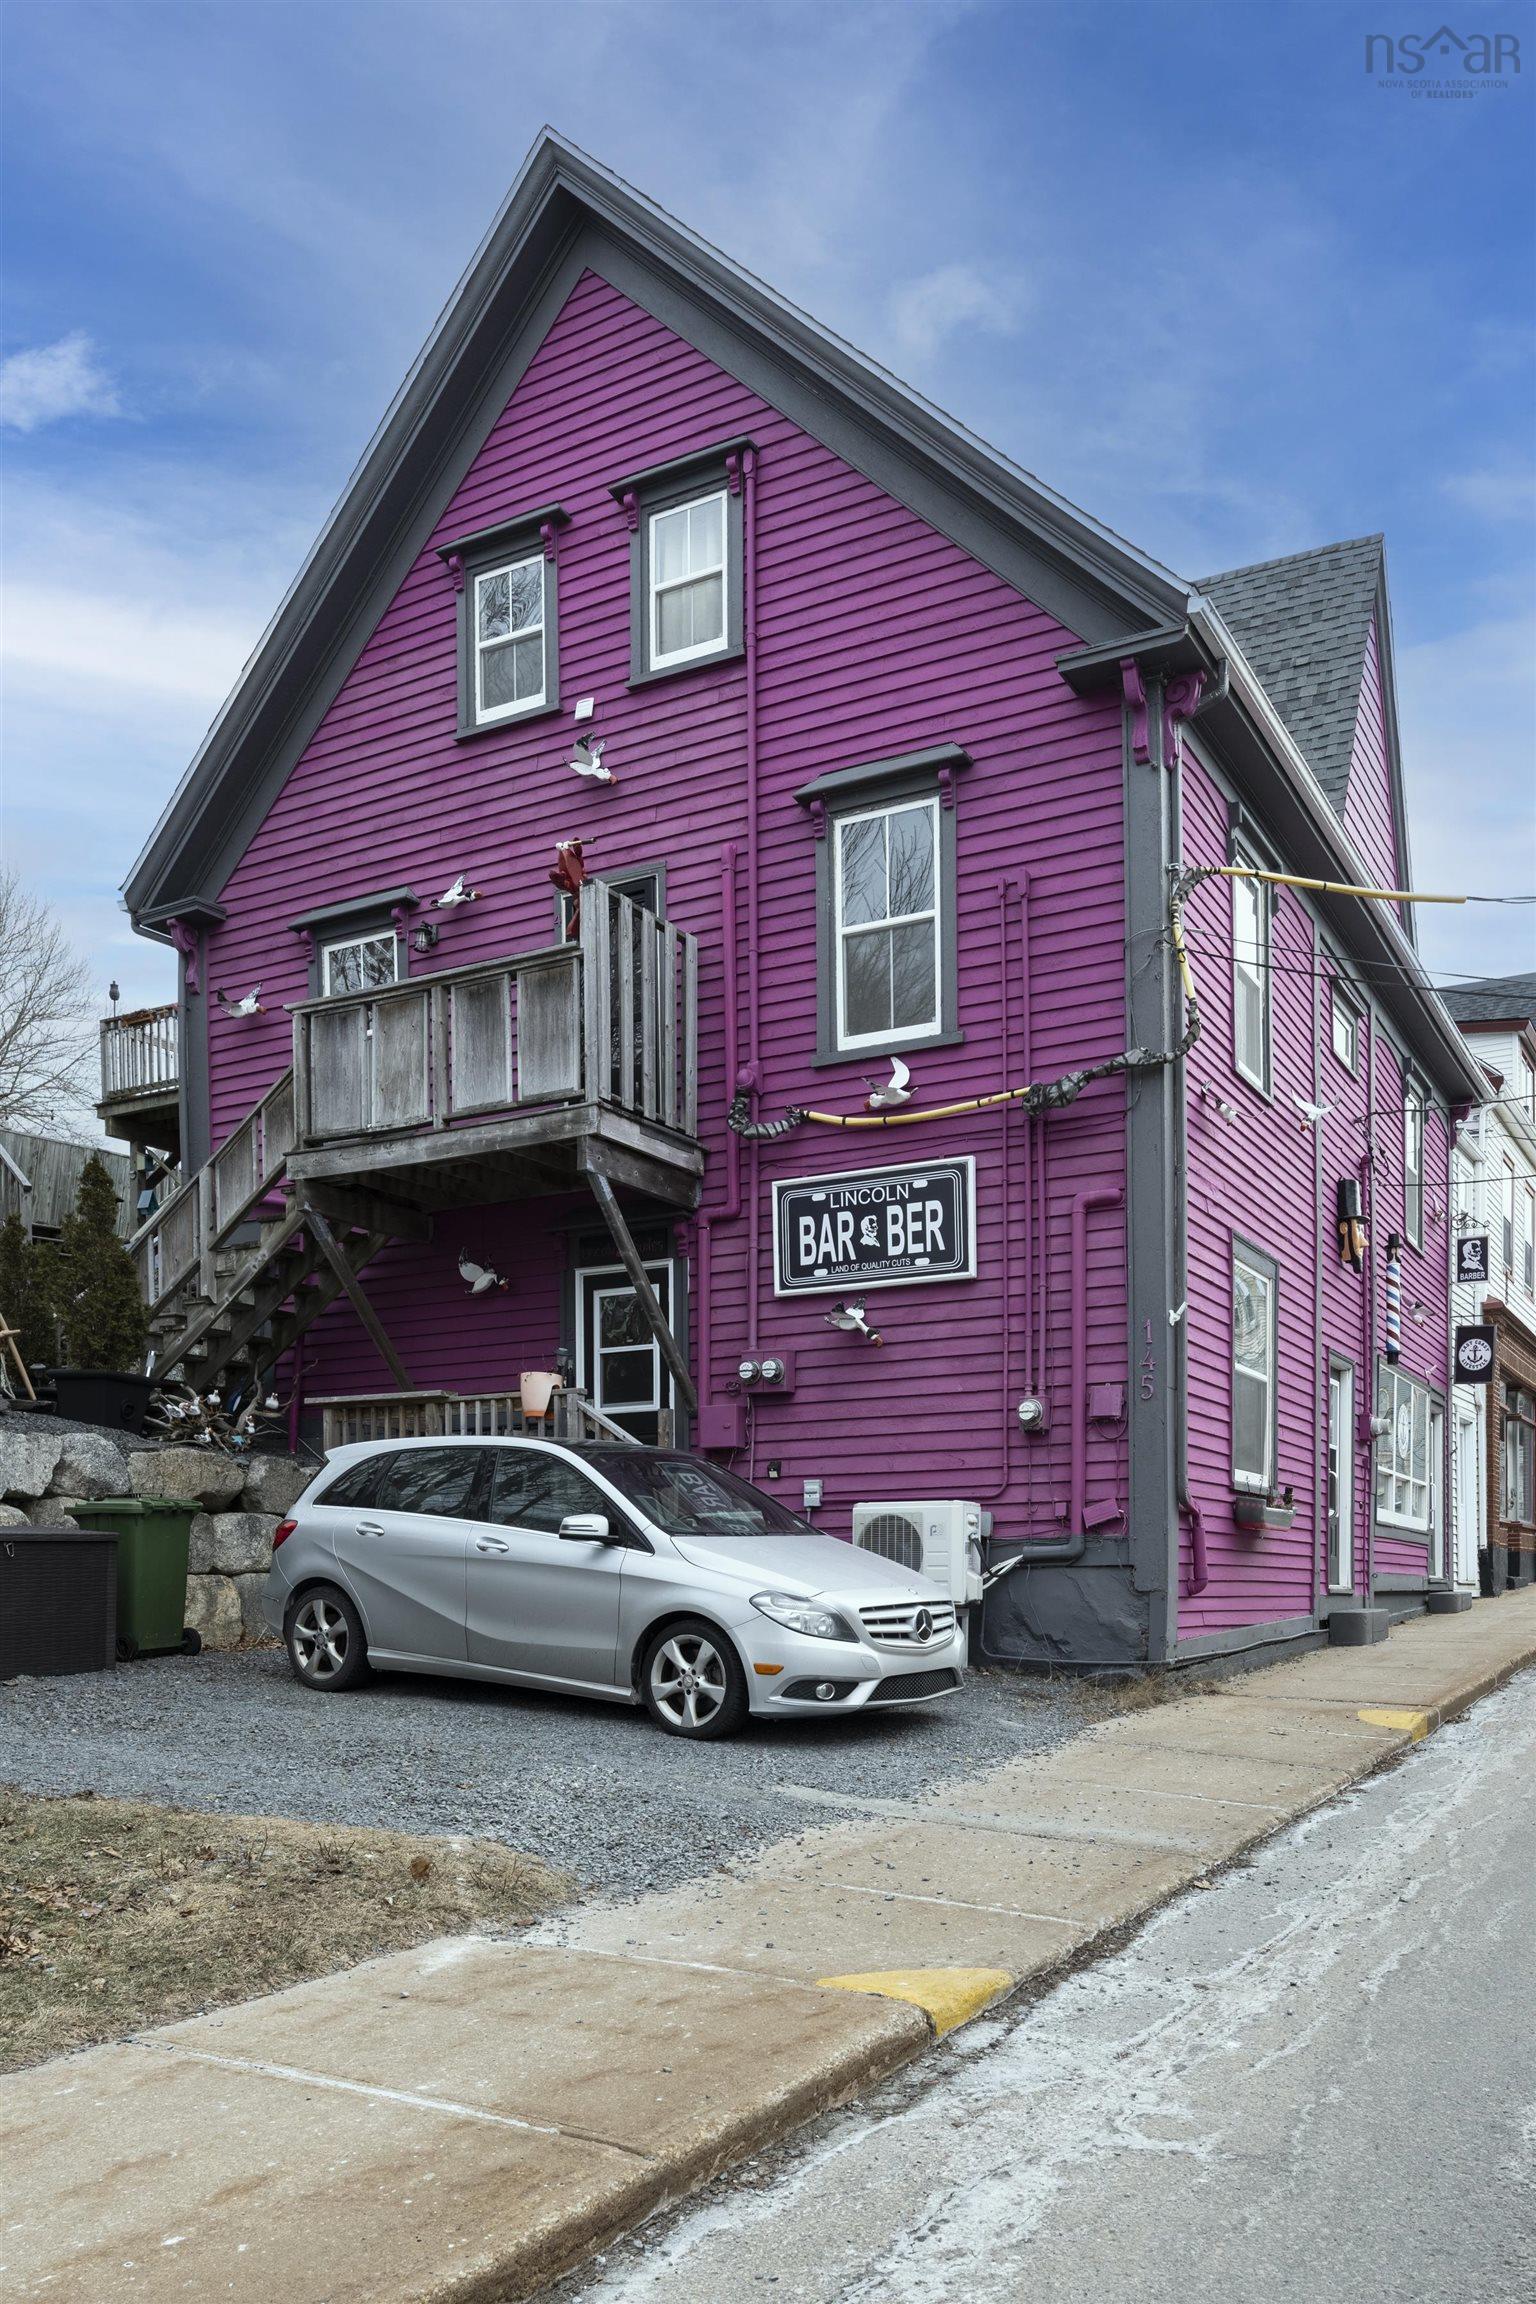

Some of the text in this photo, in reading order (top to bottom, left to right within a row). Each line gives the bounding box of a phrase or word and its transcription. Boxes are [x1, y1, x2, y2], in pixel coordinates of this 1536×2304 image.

[829, 1183, 909, 1209] LINCOLN
[799, 1199, 946, 1267] BAR BER
[831, 1258, 911, 1274] LAND OF QUALITY CUTS
[1460, 1271, 1486, 1281] BARBER
[1461, 1340, 1489, 1352] EAST COAST
[1139, 1319, 1159, 1400] 145
[1461, 1358, 1488, 1369] LIFESTYLE
